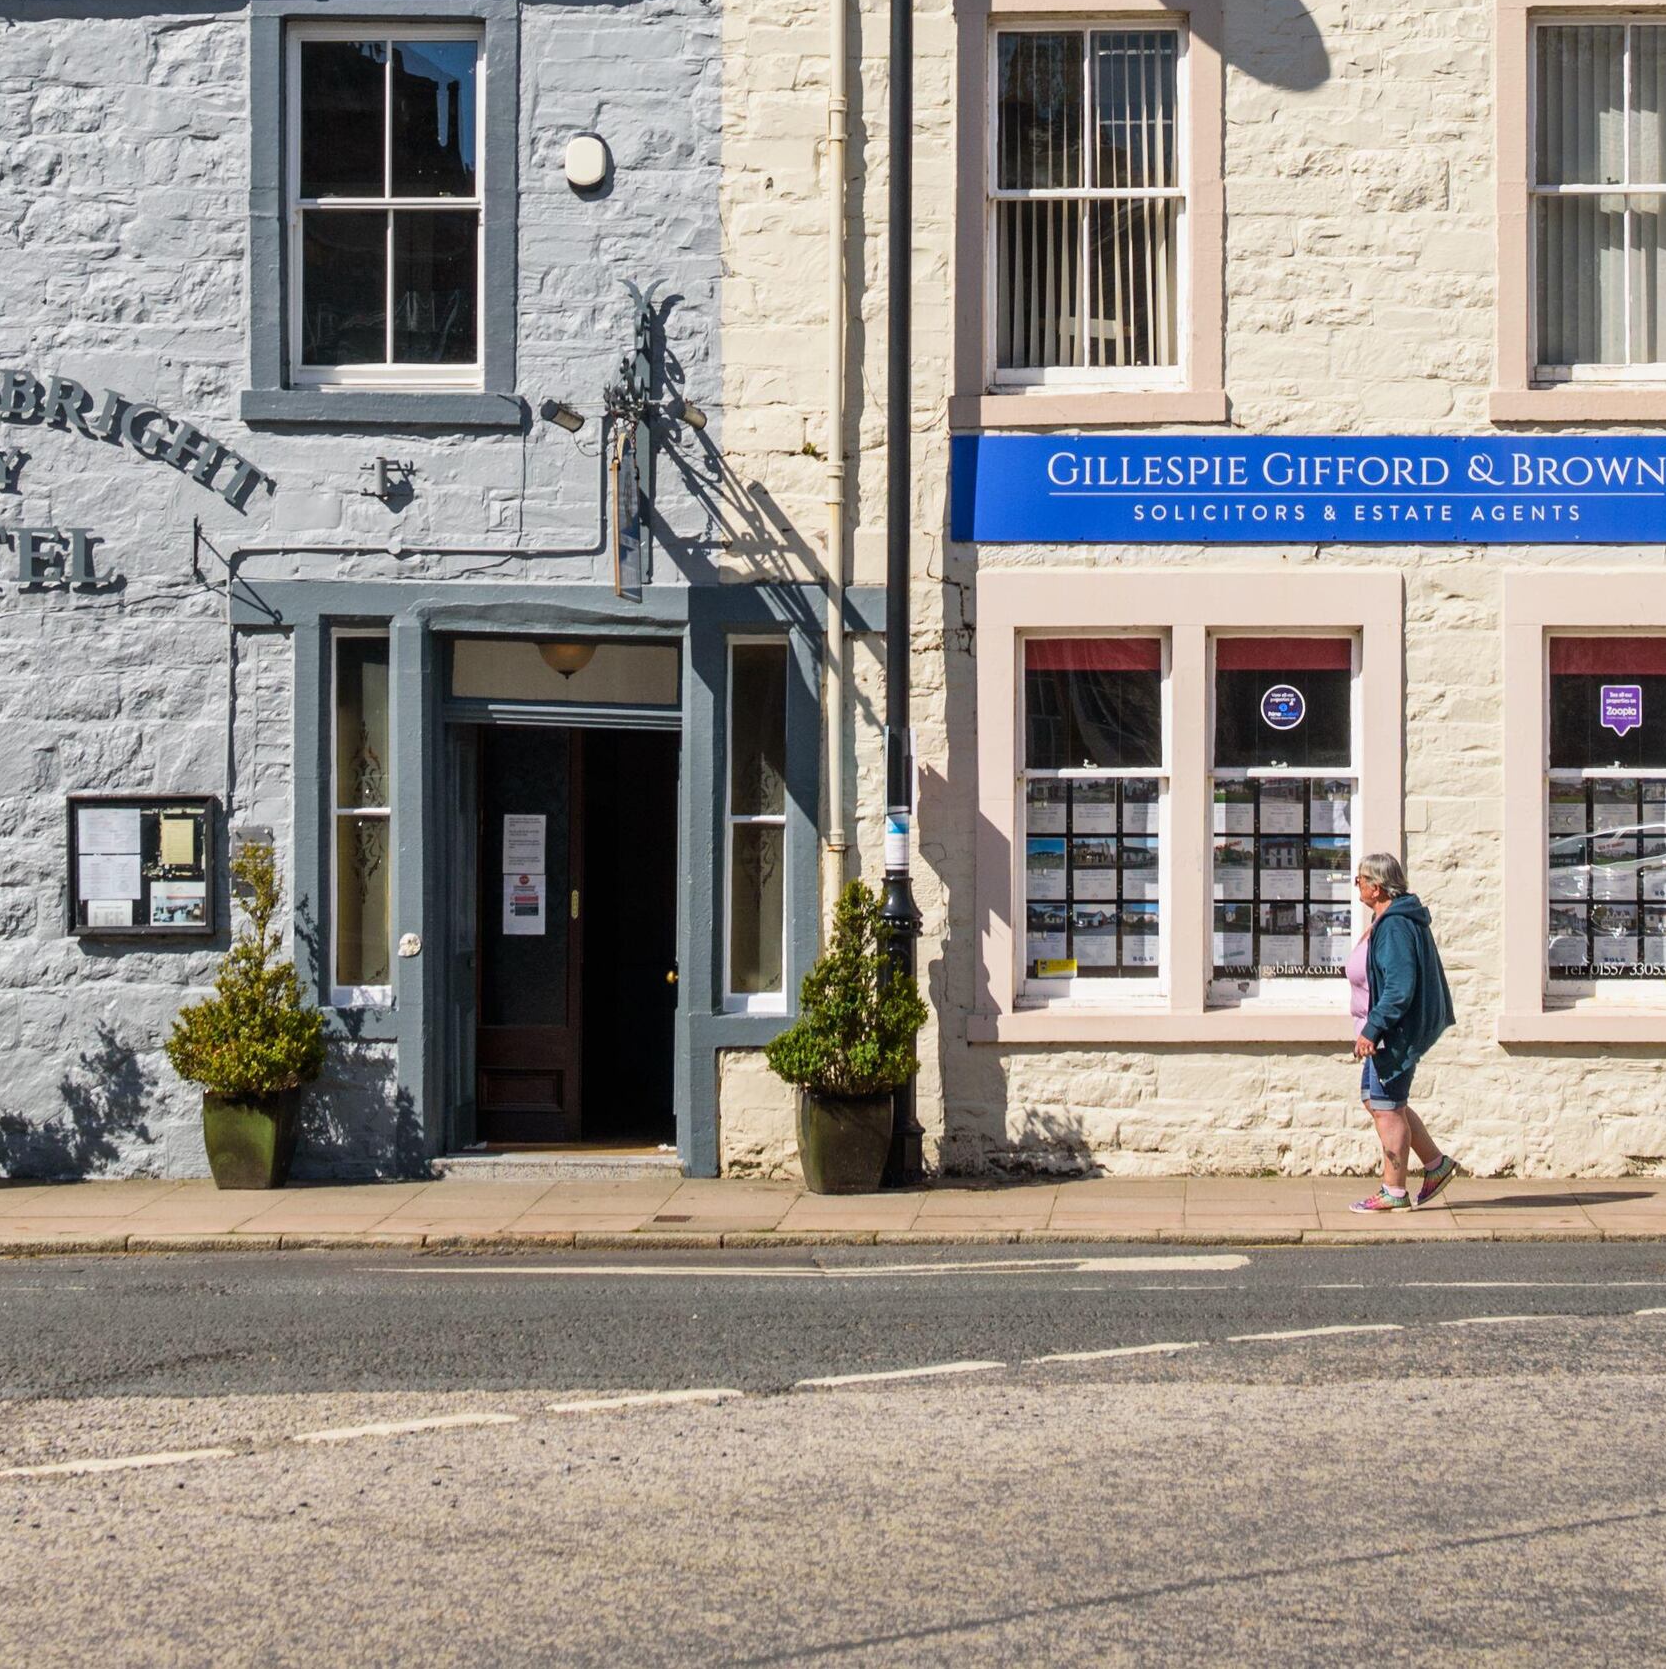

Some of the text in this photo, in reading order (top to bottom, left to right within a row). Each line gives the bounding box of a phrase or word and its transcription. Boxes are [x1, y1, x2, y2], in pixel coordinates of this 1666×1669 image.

[1046, 451, 1666, 486] GILLESPIE GIFFORD & BROWN
[1133, 504, 1581, 521] SOLICITORS & ESTATE AGENTS
[1606, 706, 1637, 717] Zoopla
[1590, 962, 1625, 976] 01557
